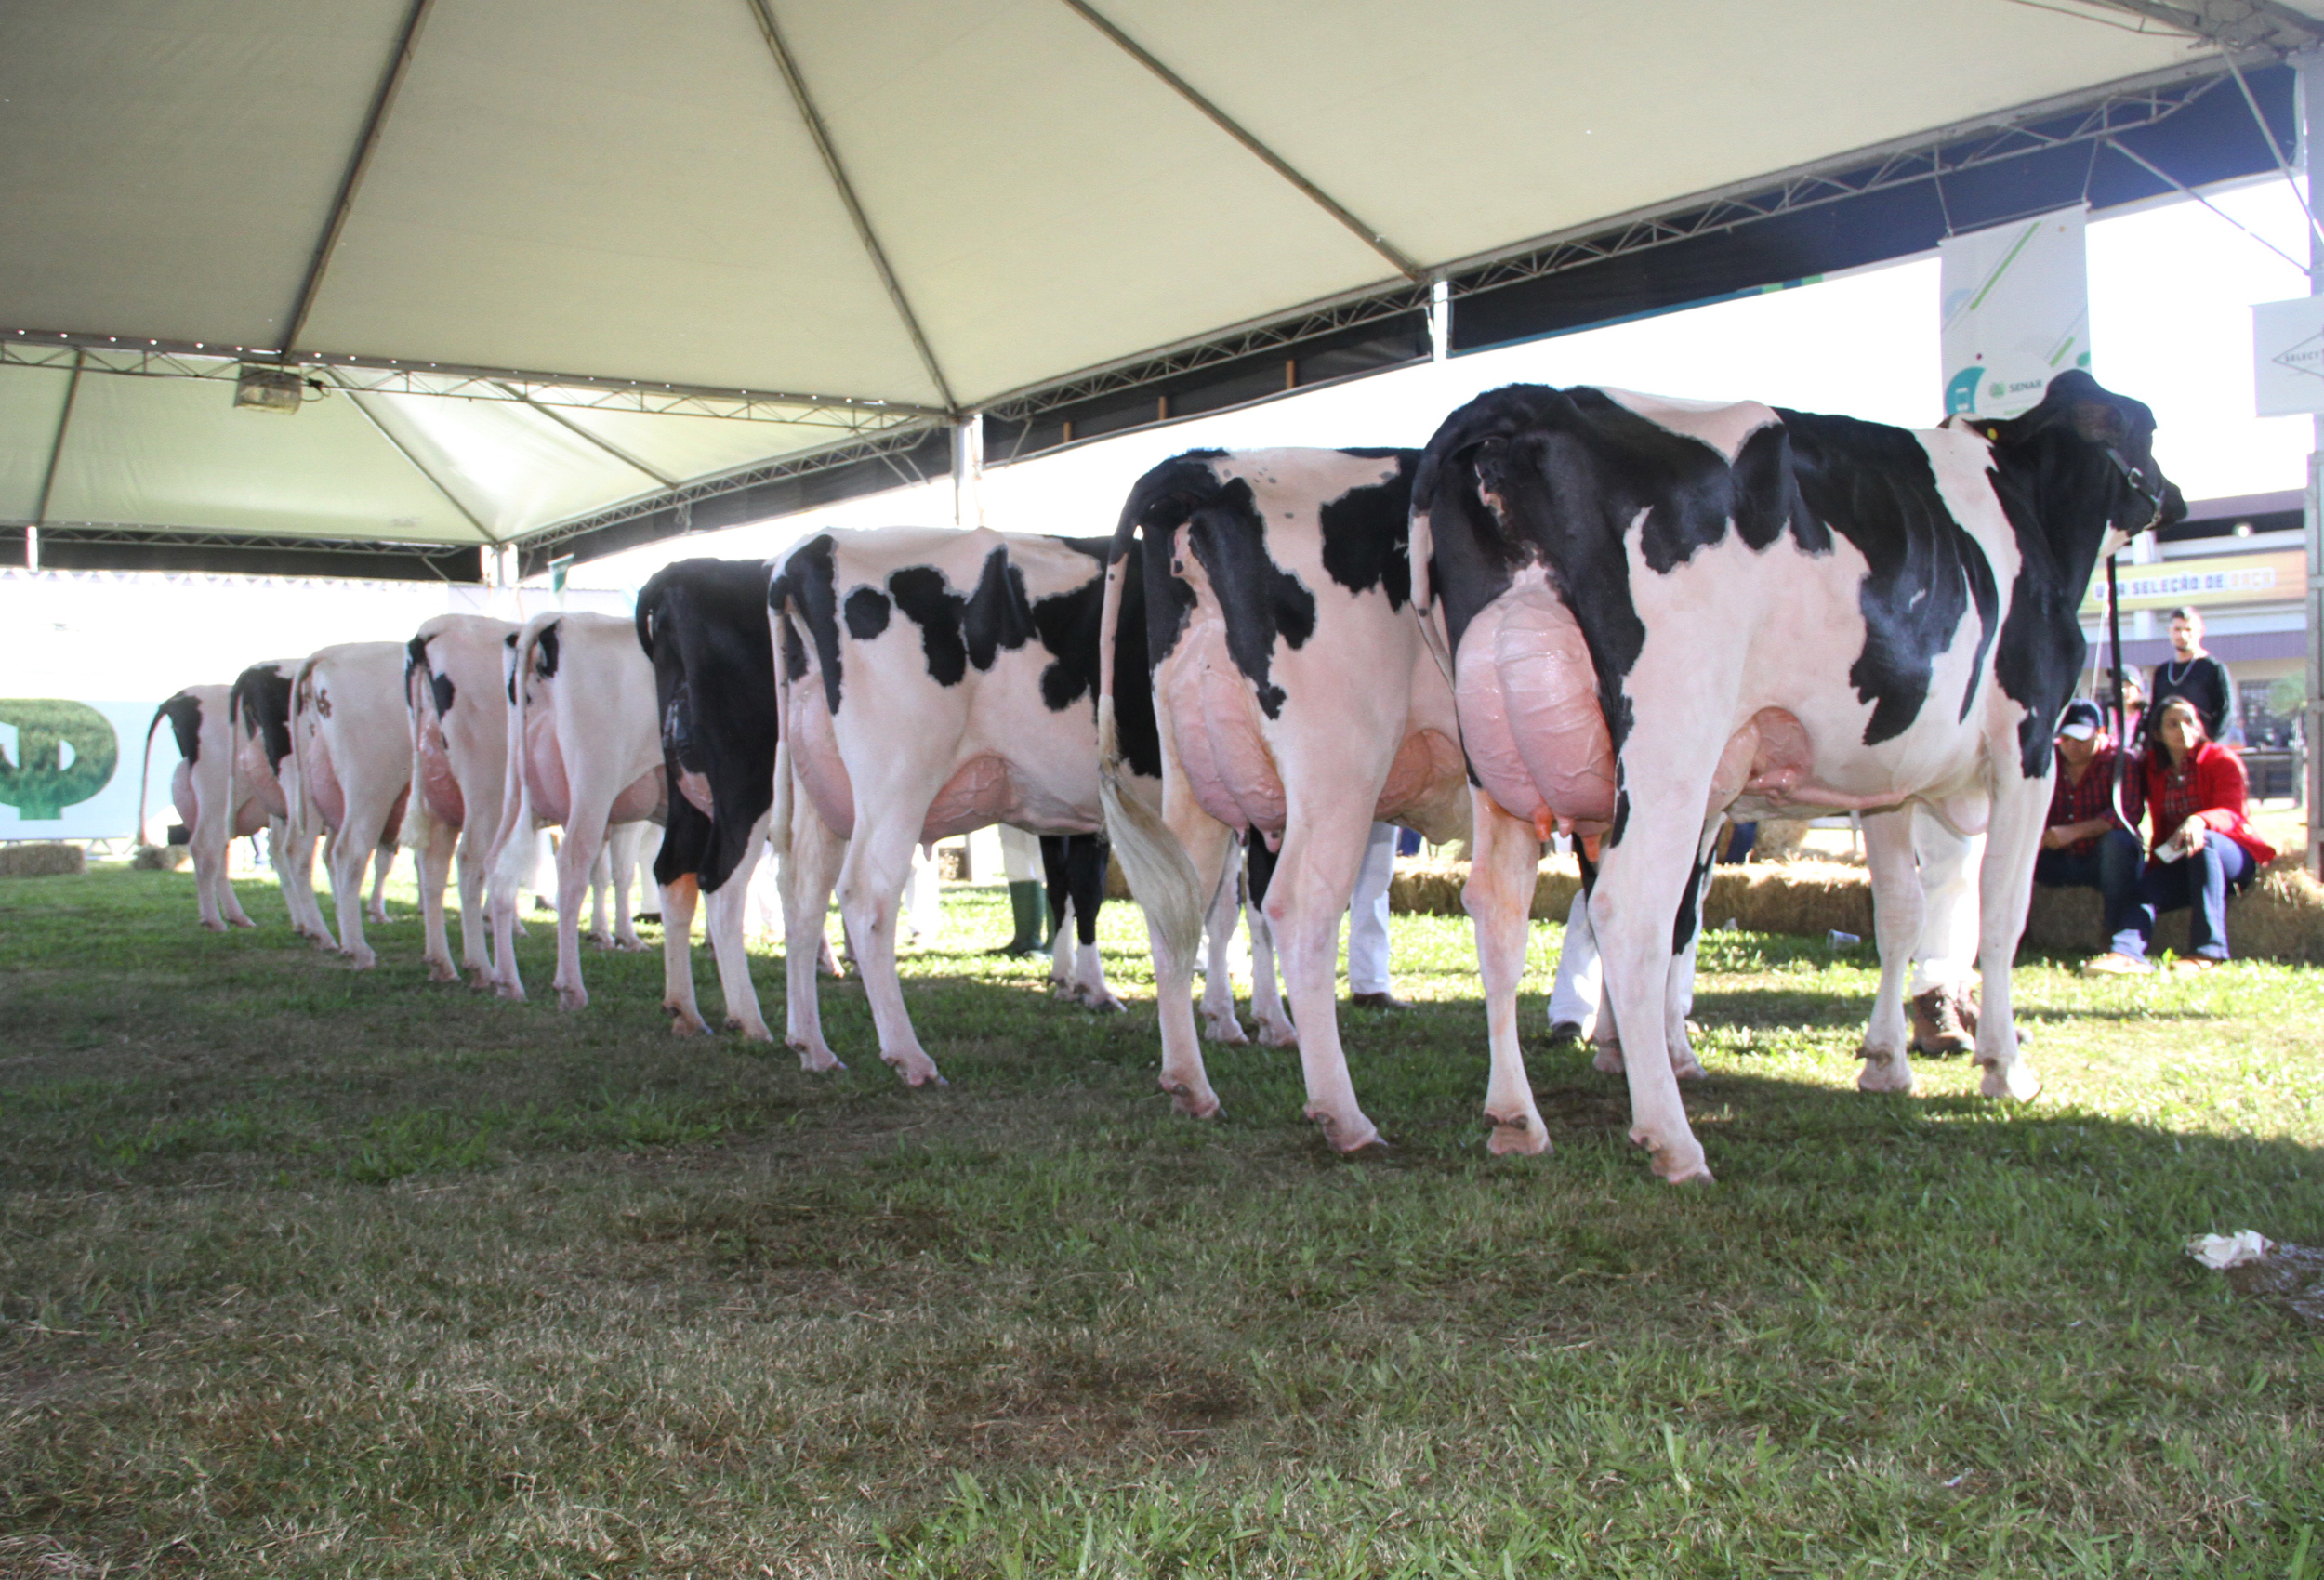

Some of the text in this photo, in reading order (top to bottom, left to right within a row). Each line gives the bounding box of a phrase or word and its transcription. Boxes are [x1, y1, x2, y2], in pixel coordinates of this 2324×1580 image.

[2008, 379, 2043, 392] SENAR
[2095, 584, 2125, 599] UA
[2133, 573, 2199, 595] SELEÇÃO
[2205, 573, 2224, 588] DE
